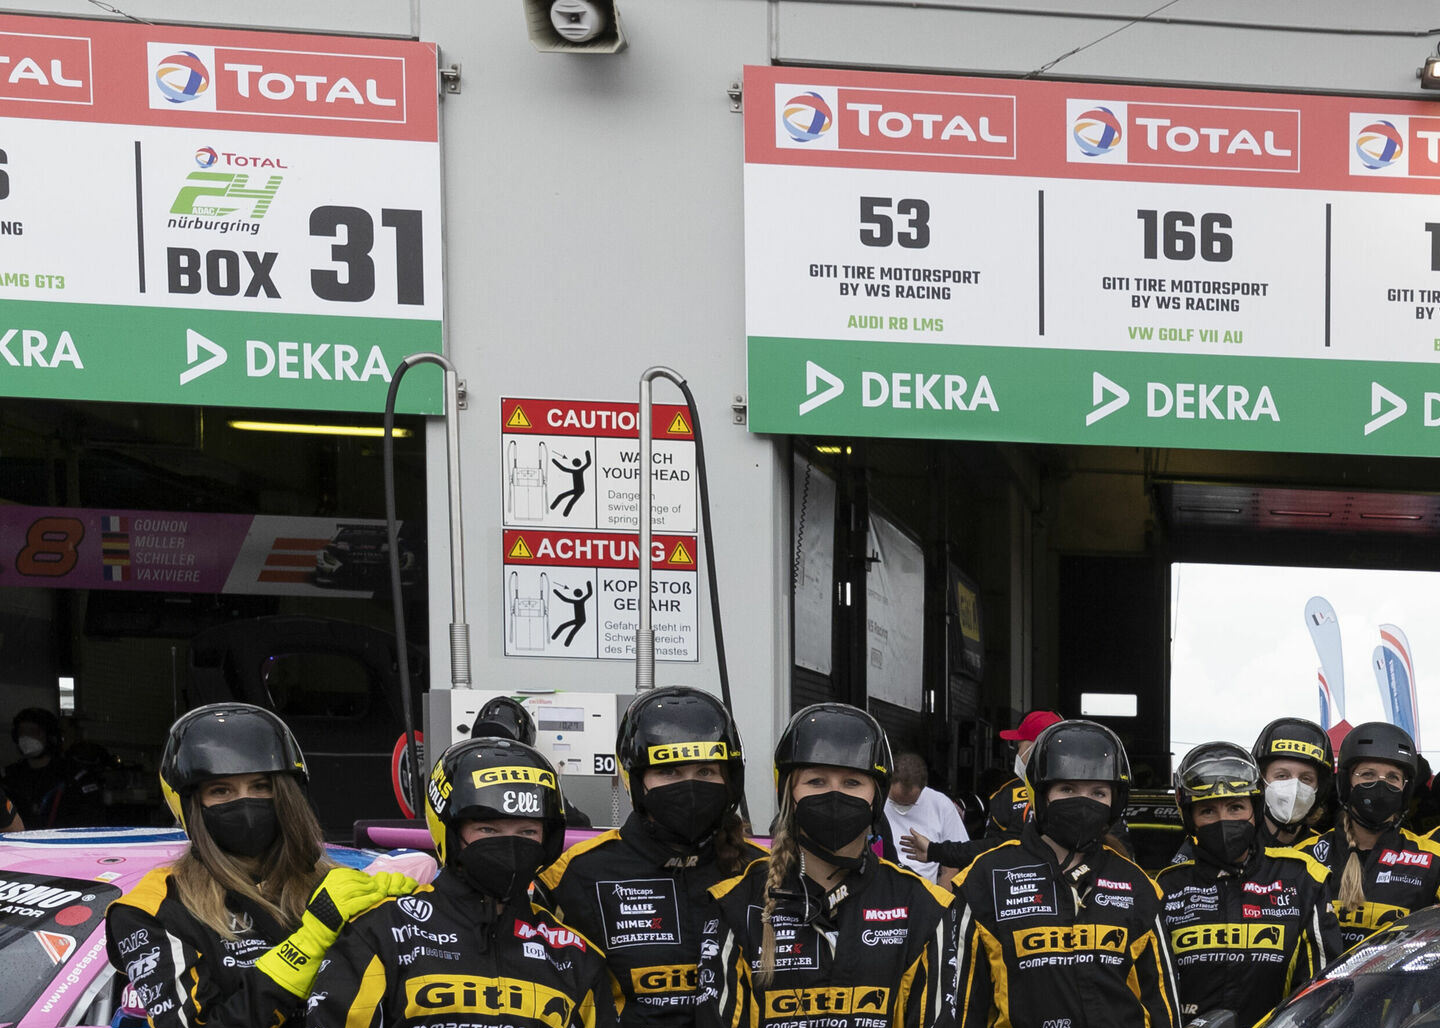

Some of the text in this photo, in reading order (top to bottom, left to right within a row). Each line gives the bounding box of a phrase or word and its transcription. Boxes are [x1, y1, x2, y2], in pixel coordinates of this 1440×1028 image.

[224, 63, 396, 106] TOTAL
[847, 103, 1007, 143] TOTAL
[1136, 118, 1291, 156] TOTAL
[222, 153, 288, 168] TOTAL
[168, 217, 260, 235] nürburgring
[860, 196, 930, 249] 53
[1137, 209, 1233, 262] 166
[167, 206, 424, 305] BOX 31
[35, 274, 65, 289] GT3
[810, 264, 980, 284] GITI TIRE MOTORSPORT
[840, 283, 950, 300] BY WS RACING
[1103, 277, 1268, 296] GITI TIRE MOTORSPORT
[1132, 295, 1239, 312] BY WS RACING
[1388, 289, 1413, 302] GITI
[1416, 307, 1434, 319] BY
[848, 315, 943, 331] AUDI R8 LMS
[1128, 327, 1243, 344] VW GOLF VII AU
[246, 340, 391, 382] DEKRA
[862, 372, 999, 411] DEKRA
[1147, 382, 1280, 421] DEKRA
[547, 409, 639, 429] CAUTIO
[134, 519, 188, 533] GOUNON
[15, 517, 85, 577] 8
[135, 534, 185, 549] MÜLLER
[135, 552, 195, 566] SCHILLER
[136, 568, 200, 583] VAXIVIERE
[653, 747, 699, 761] Giti
[595, 757, 614, 771] 30
[480, 770, 529, 782] Giti
[503, 791, 539, 812] Elli
[1382, 852, 1429, 865] MOTUL
[1098, 879, 1131, 890] MOTUL
[1244, 882, 1281, 893] MOTUL
[865, 908, 908, 920] MOTUL
[1000, 906, 1052, 917] SCHAEFFLER
[611, 933, 674, 945] SCHAEFFLER
[1022, 928, 1088, 950] Giti
[1176, 928, 1240, 948] Giti
[281, 943, 306, 967] OMP
[1100, 955, 1124, 965] TIRES
[1251, 952, 1284, 962] TIRES
[415, 981, 523, 1010] Giti
[772, 990, 846, 1014] Giti
[854, 1018, 887, 1028] TIRES
